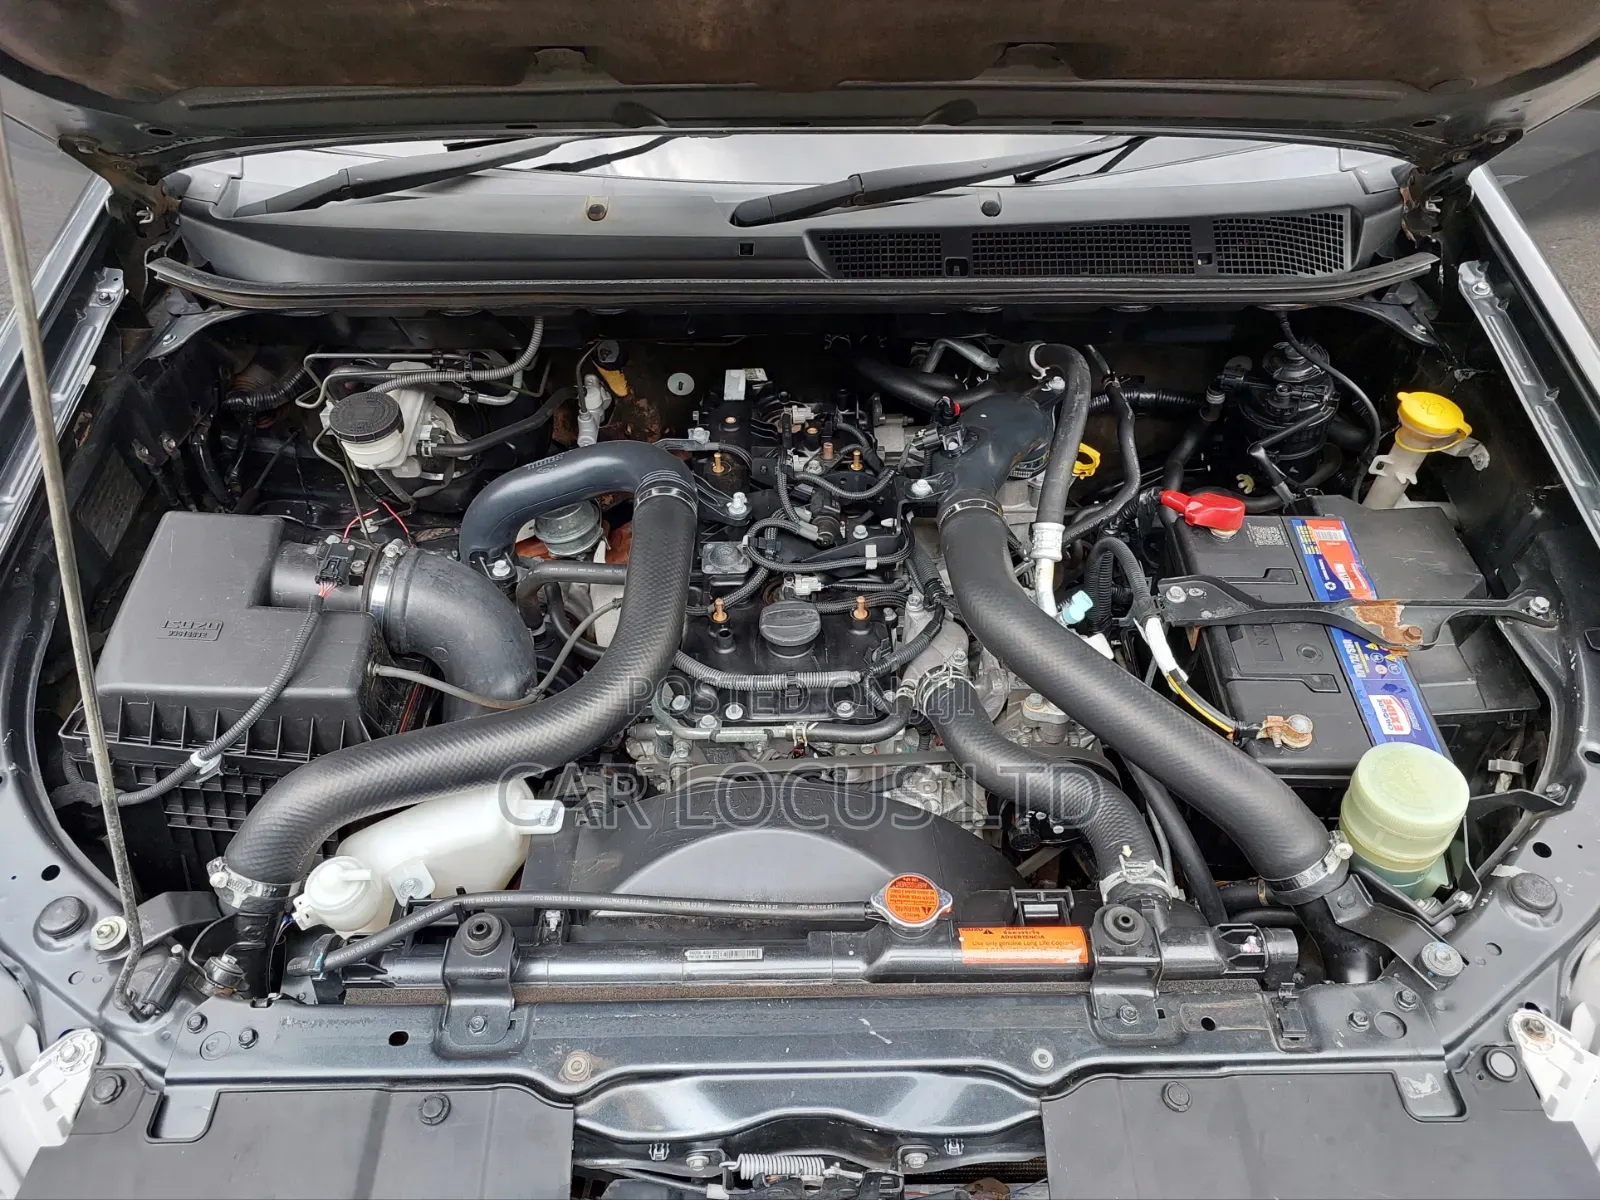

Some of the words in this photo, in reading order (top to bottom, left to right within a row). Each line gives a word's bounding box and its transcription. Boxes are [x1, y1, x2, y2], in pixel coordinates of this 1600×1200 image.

[160, 620, 220, 630] ISUZU
[1376, 698, 1394, 731] CHLORIDE
[1381, 698, 1404, 732] EXIDE
